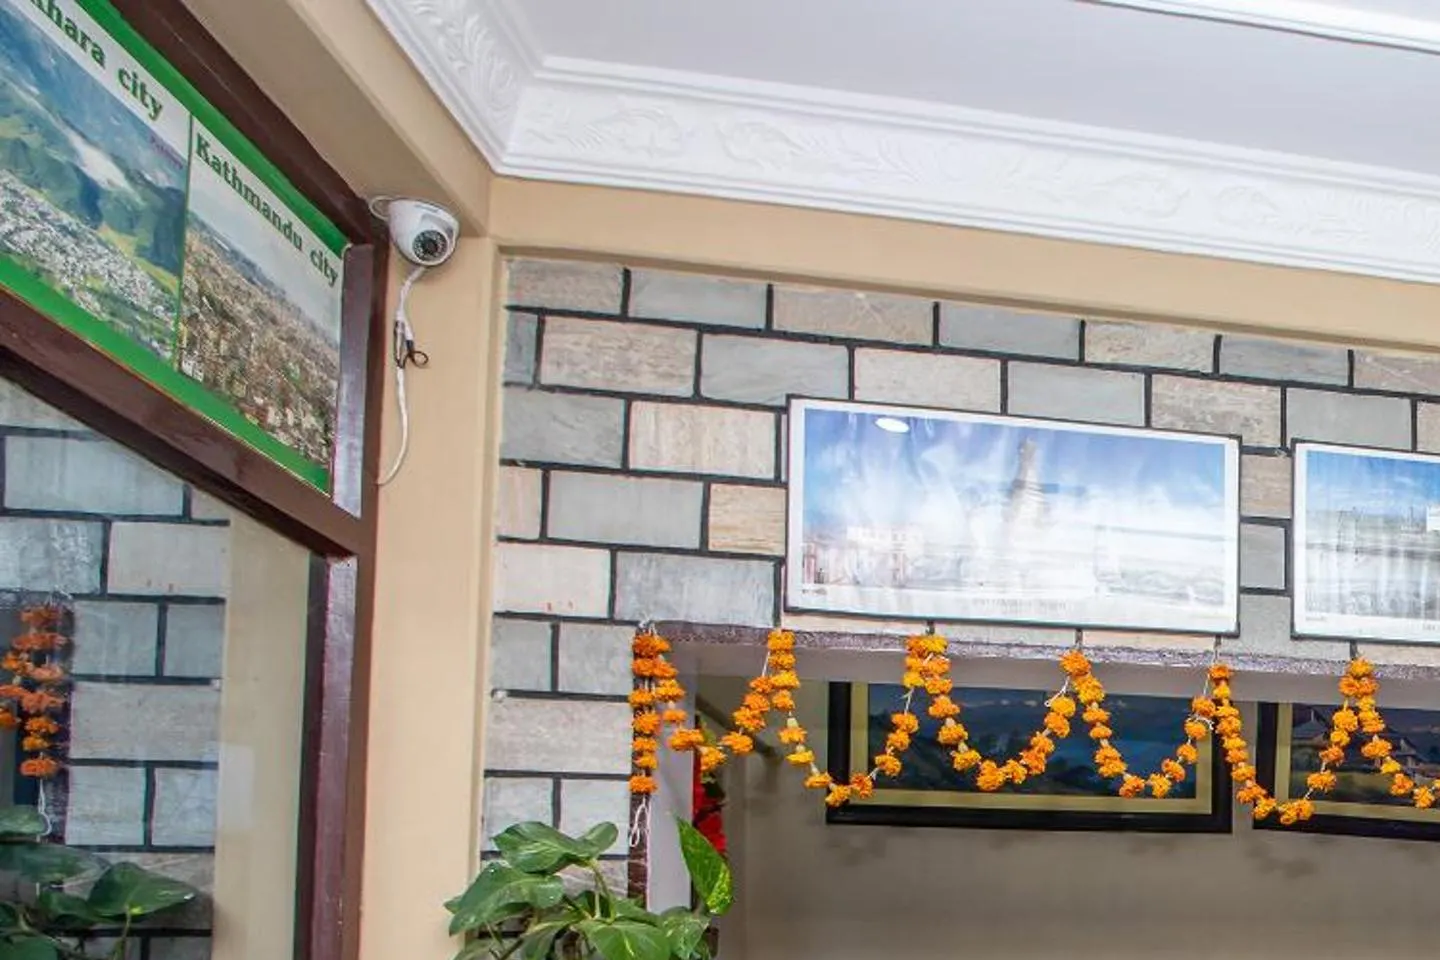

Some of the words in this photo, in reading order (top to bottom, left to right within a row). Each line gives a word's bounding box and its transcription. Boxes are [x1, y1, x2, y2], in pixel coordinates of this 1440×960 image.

[118, 67, 163, 121] city
[197, 133, 303, 252] Kathmandu
[311, 249, 338, 287] city
